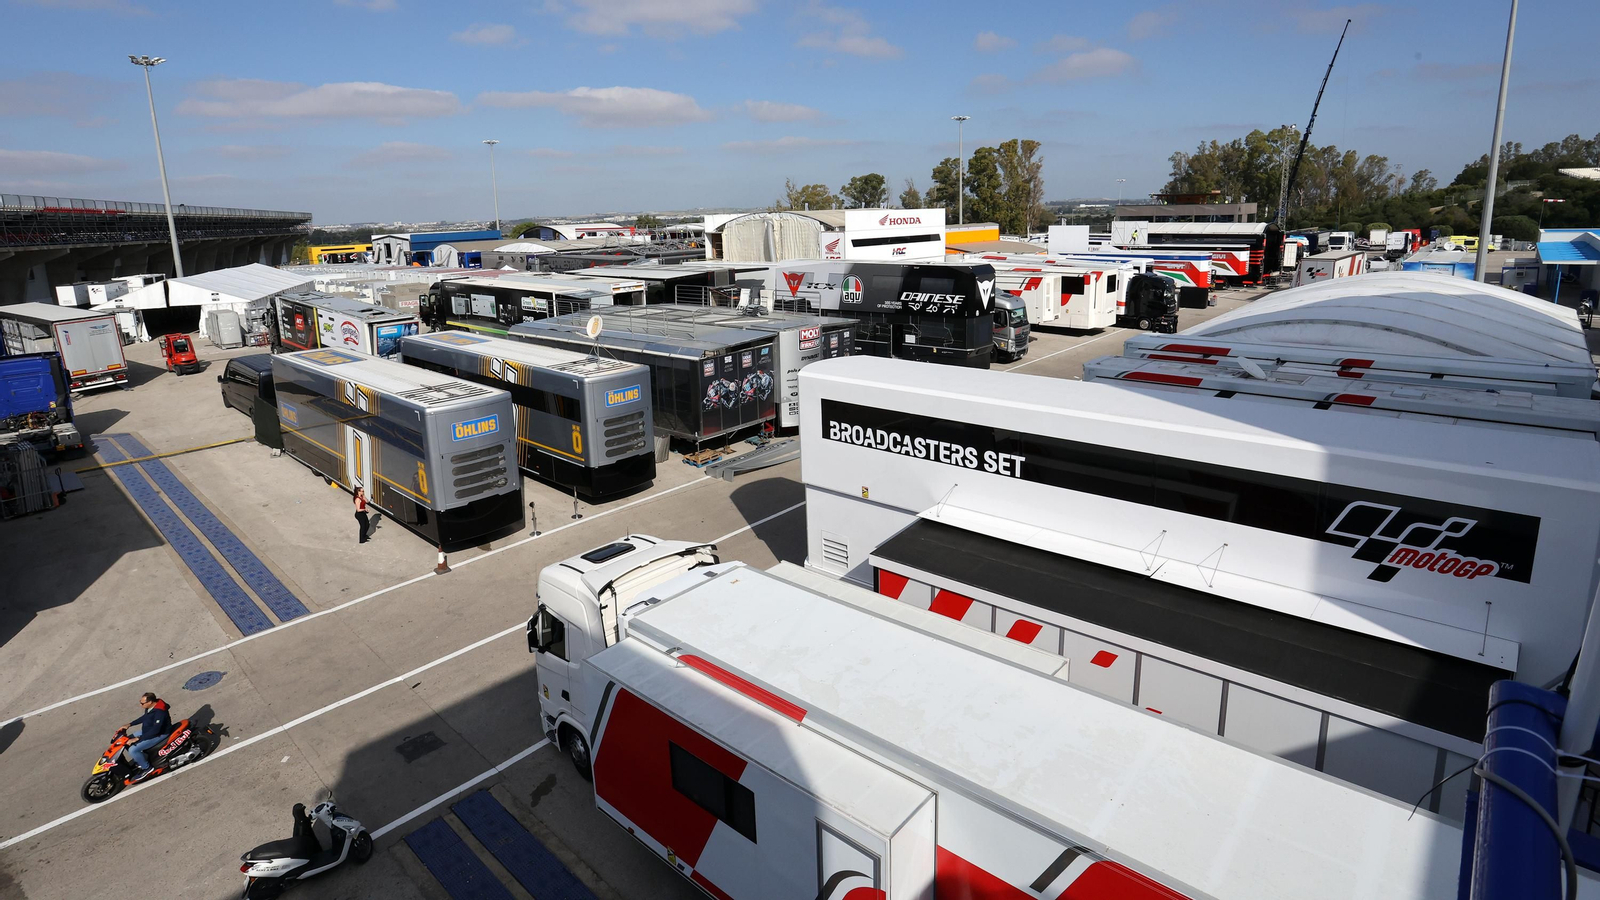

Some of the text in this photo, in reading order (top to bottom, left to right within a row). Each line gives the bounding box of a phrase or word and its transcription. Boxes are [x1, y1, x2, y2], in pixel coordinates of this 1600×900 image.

[889, 217, 921, 226] HONDA
[844, 292, 861, 302] agv
[900, 291, 966, 305] DAINESE
[801, 327, 820, 339] MOLY
[608, 388, 639, 405] ÖHLINS
[455, 420, 496, 439] ÖHLINS
[829, 419, 1026, 478] BROADCASTERS SET
[158, 729, 192, 757] Red Bull
